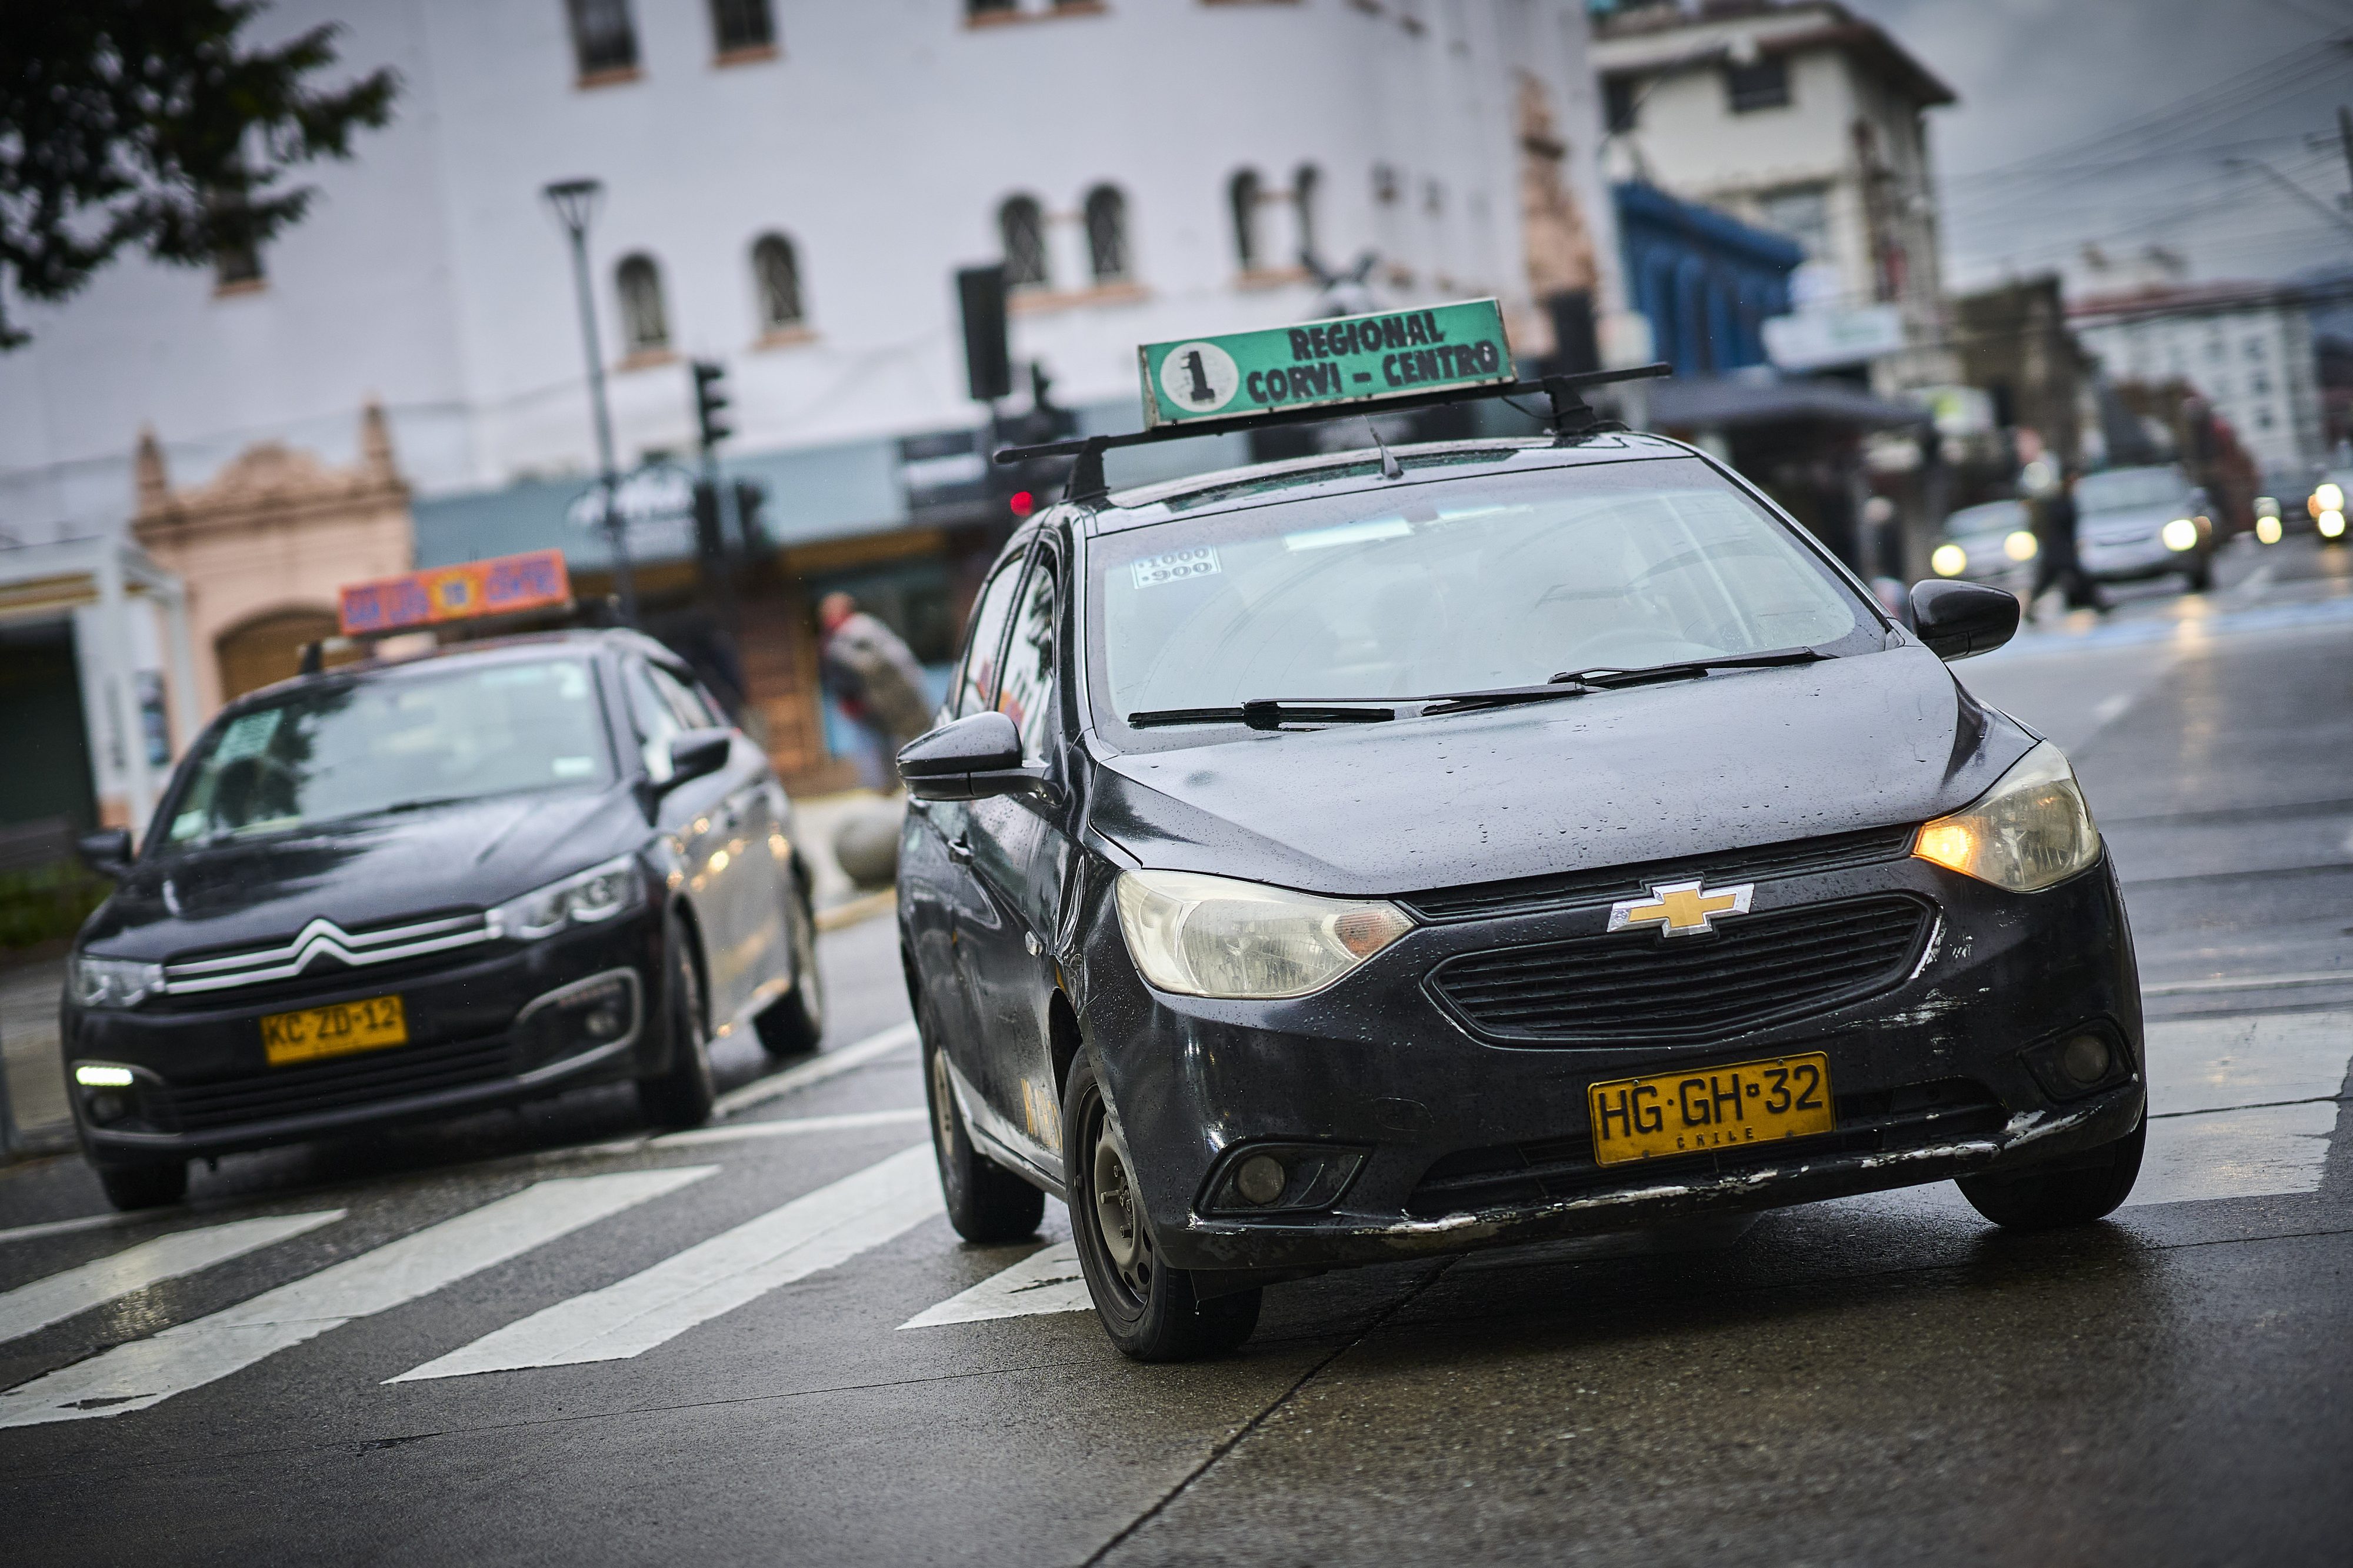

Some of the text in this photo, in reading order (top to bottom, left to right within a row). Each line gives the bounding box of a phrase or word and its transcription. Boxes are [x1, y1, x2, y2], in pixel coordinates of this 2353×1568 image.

[1287, 311, 1446, 361] REGIONAL
[1180, 350, 1215, 402] 1
[1245, 362, 1343, 404] CORVI
[1381, 340, 1501, 388] CENTRO
[1677, 1126, 1754, 1149] CHILE
